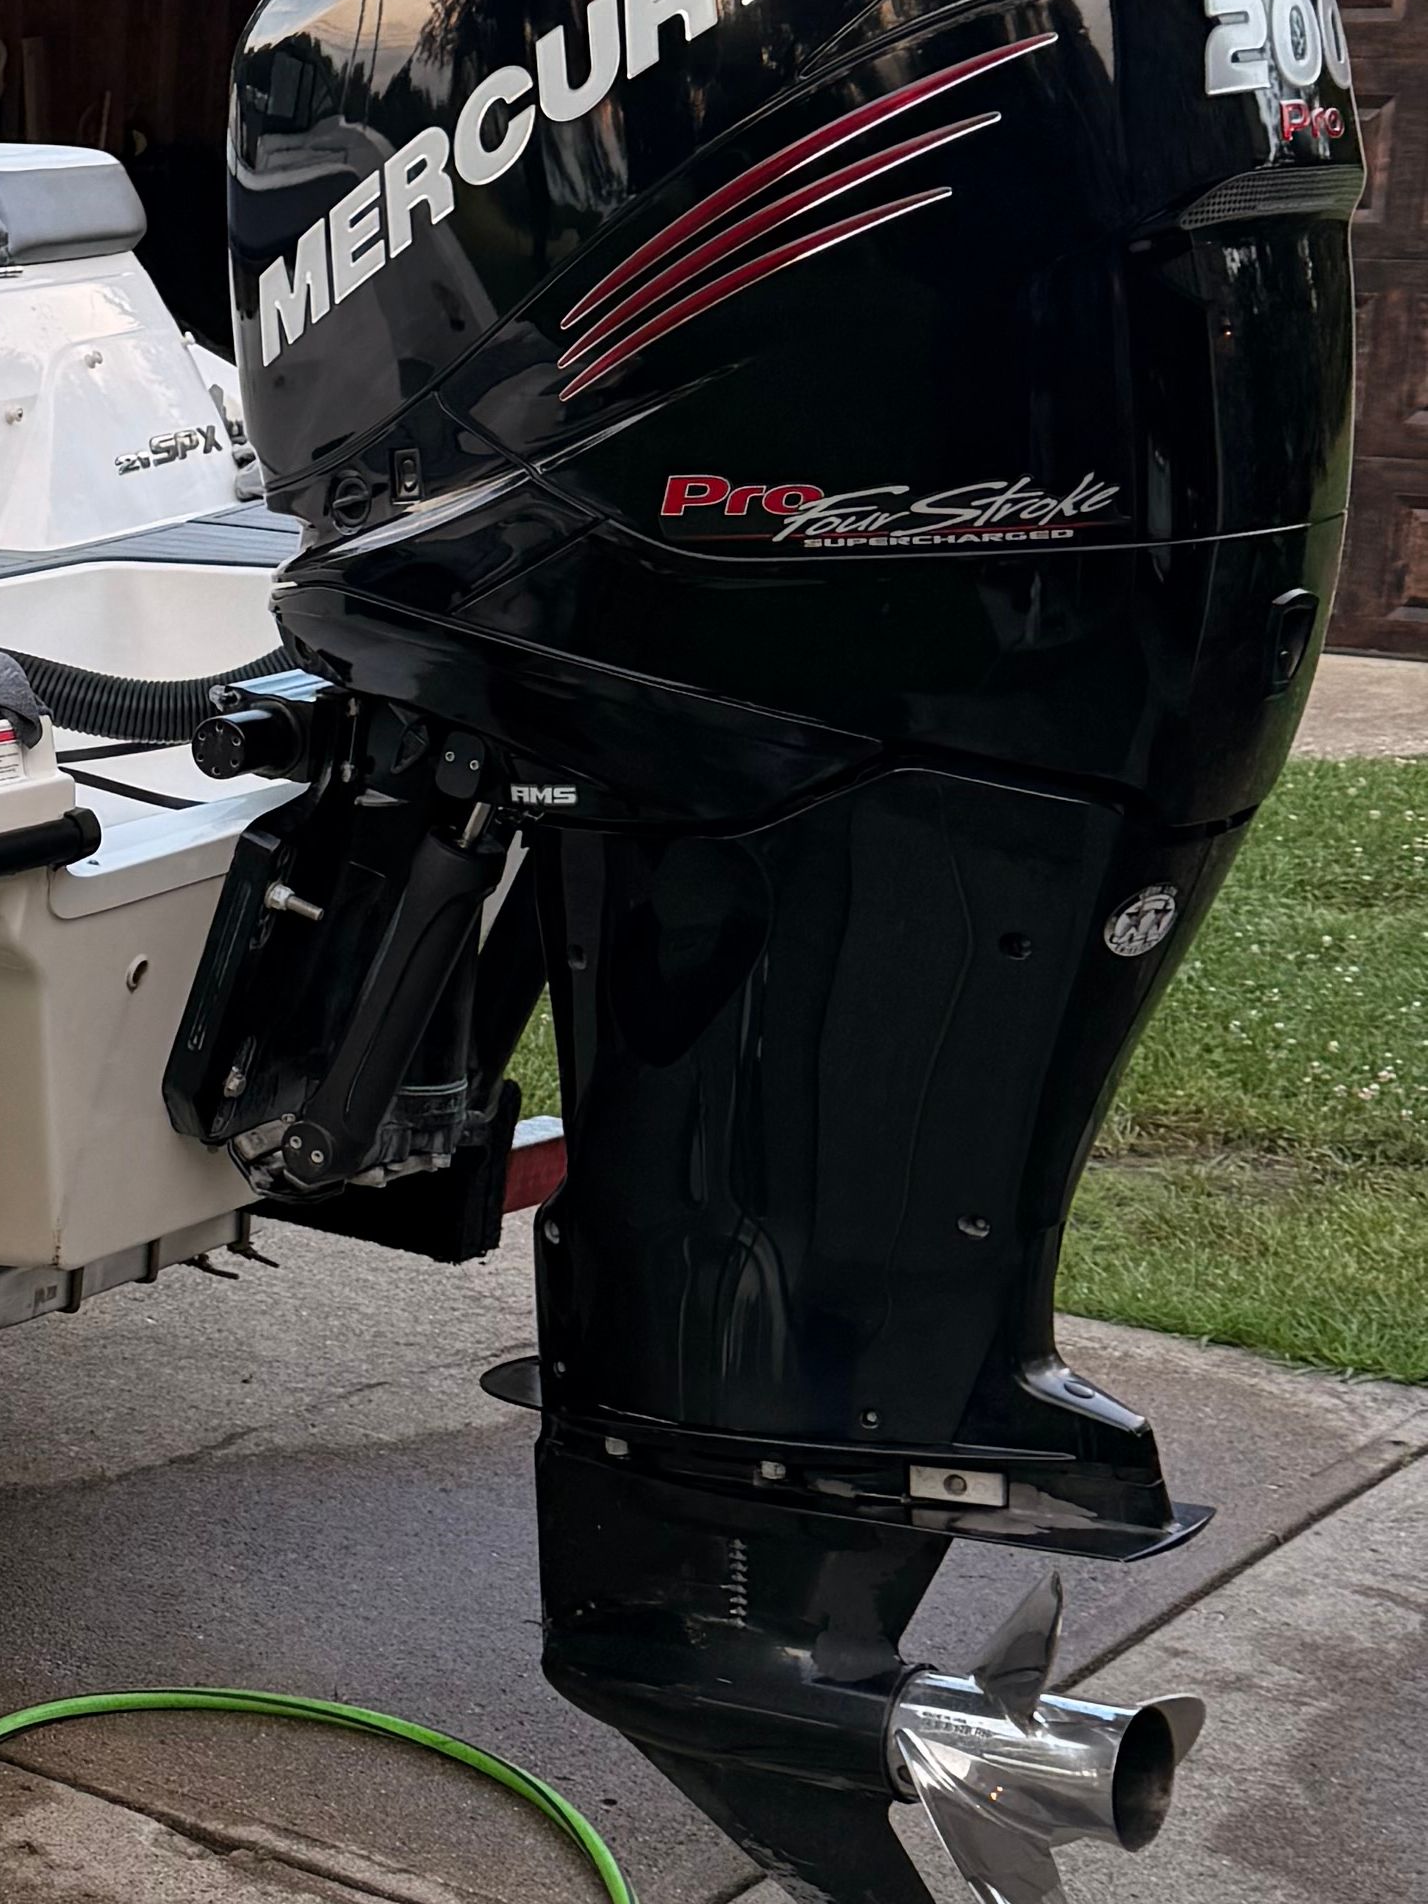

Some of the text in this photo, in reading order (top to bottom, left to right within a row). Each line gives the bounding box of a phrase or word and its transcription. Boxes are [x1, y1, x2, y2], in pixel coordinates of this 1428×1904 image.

[1280, 99, 1345, 142] Pro
[148, 425, 223, 467] SPX
[660, 474, 824, 516] Pro
[803, 529, 1074, 548] SUPERCHARGED
[510, 785, 577, 804] AMS
